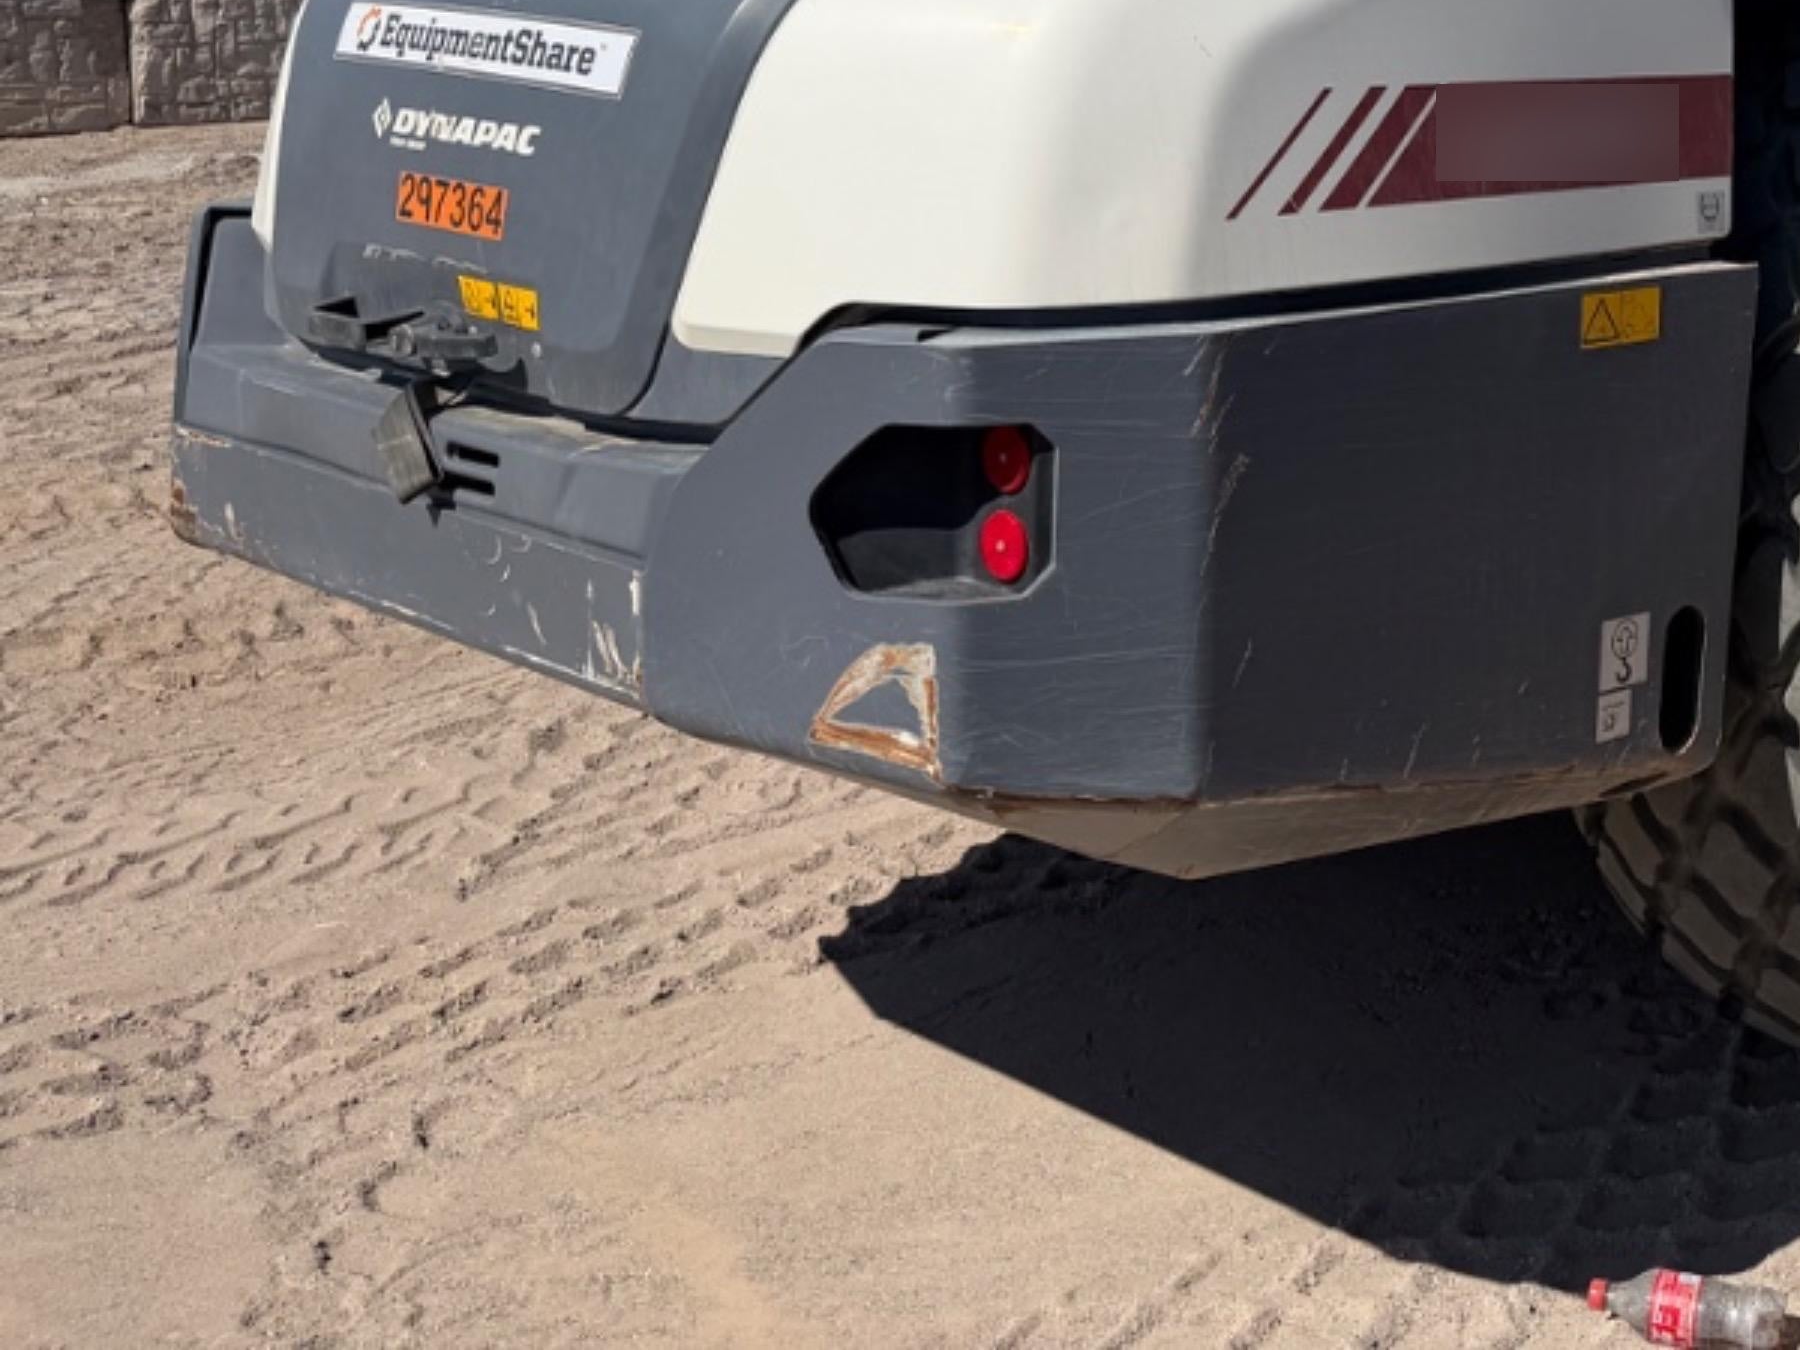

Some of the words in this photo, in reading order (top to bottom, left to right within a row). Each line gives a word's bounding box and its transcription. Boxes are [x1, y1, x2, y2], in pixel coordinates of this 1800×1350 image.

[379, 13, 597, 76] EquipmentShare
[392, 106, 542, 157] DYNAPAC
[398, 172, 503, 235] 297364
